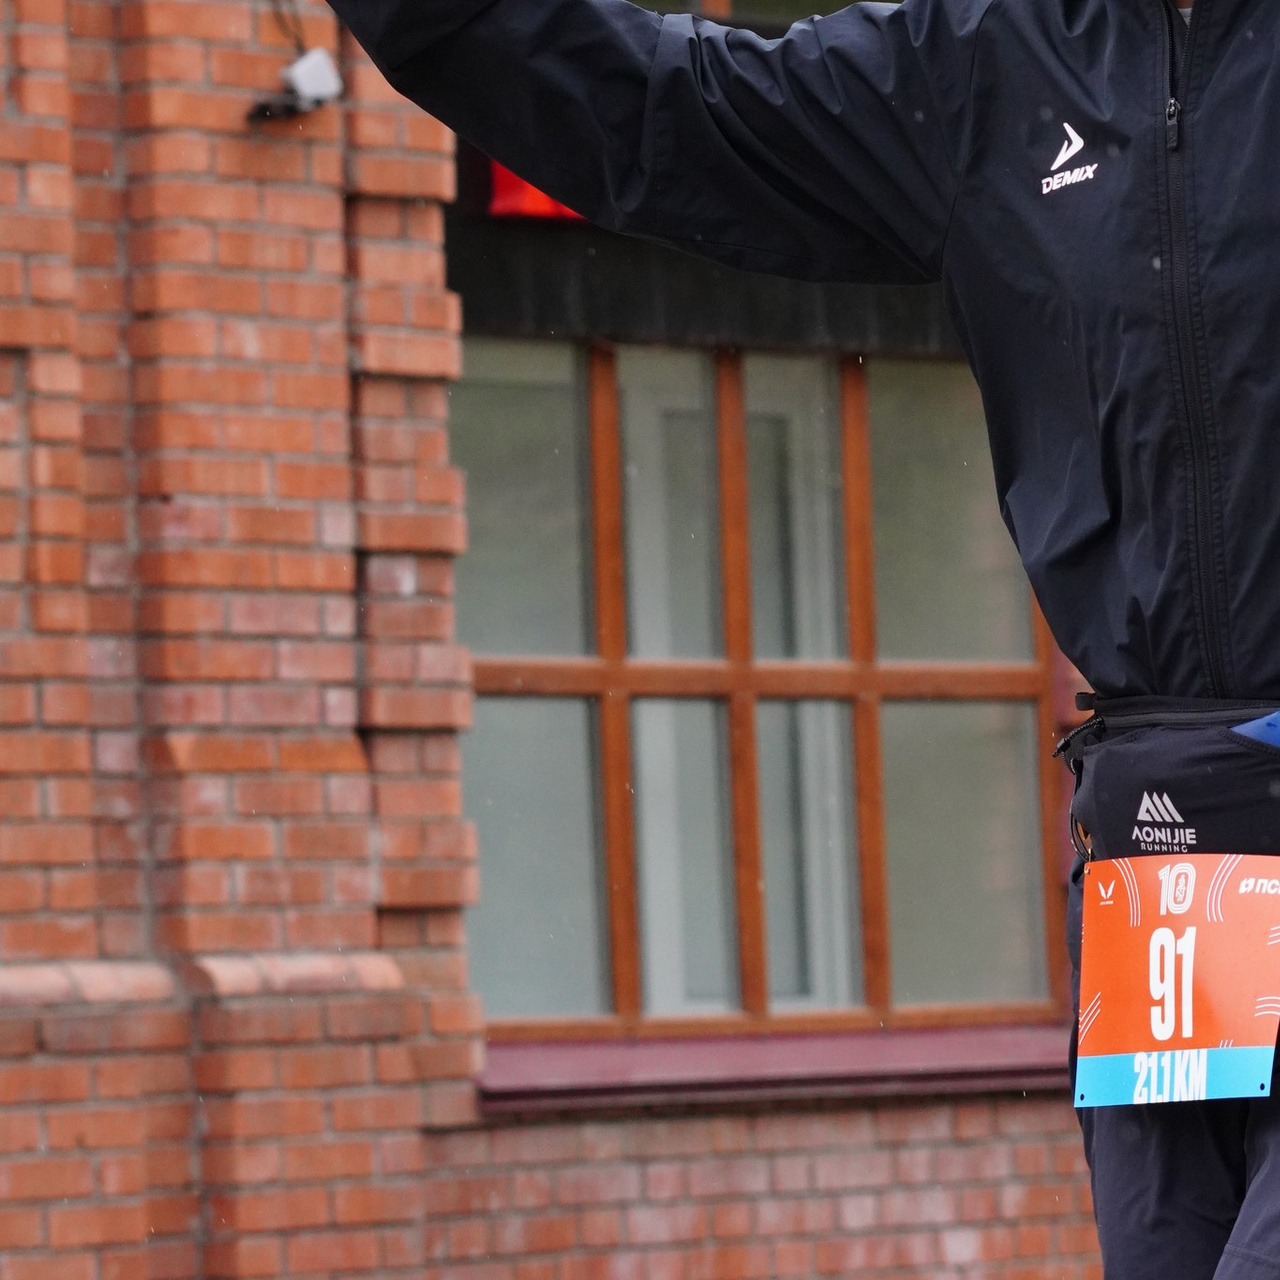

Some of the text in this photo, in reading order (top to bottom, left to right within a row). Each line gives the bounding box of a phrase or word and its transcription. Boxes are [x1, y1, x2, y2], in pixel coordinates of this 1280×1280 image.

[1041, 163, 1098, 194] DEMIX
[1131, 825, 1197, 845] AONIJIE
[1140, 842, 1188, 853] RUNNING
[1157, 862, 1196, 916] 10
[1149, 926, 1197, 1041] 91
